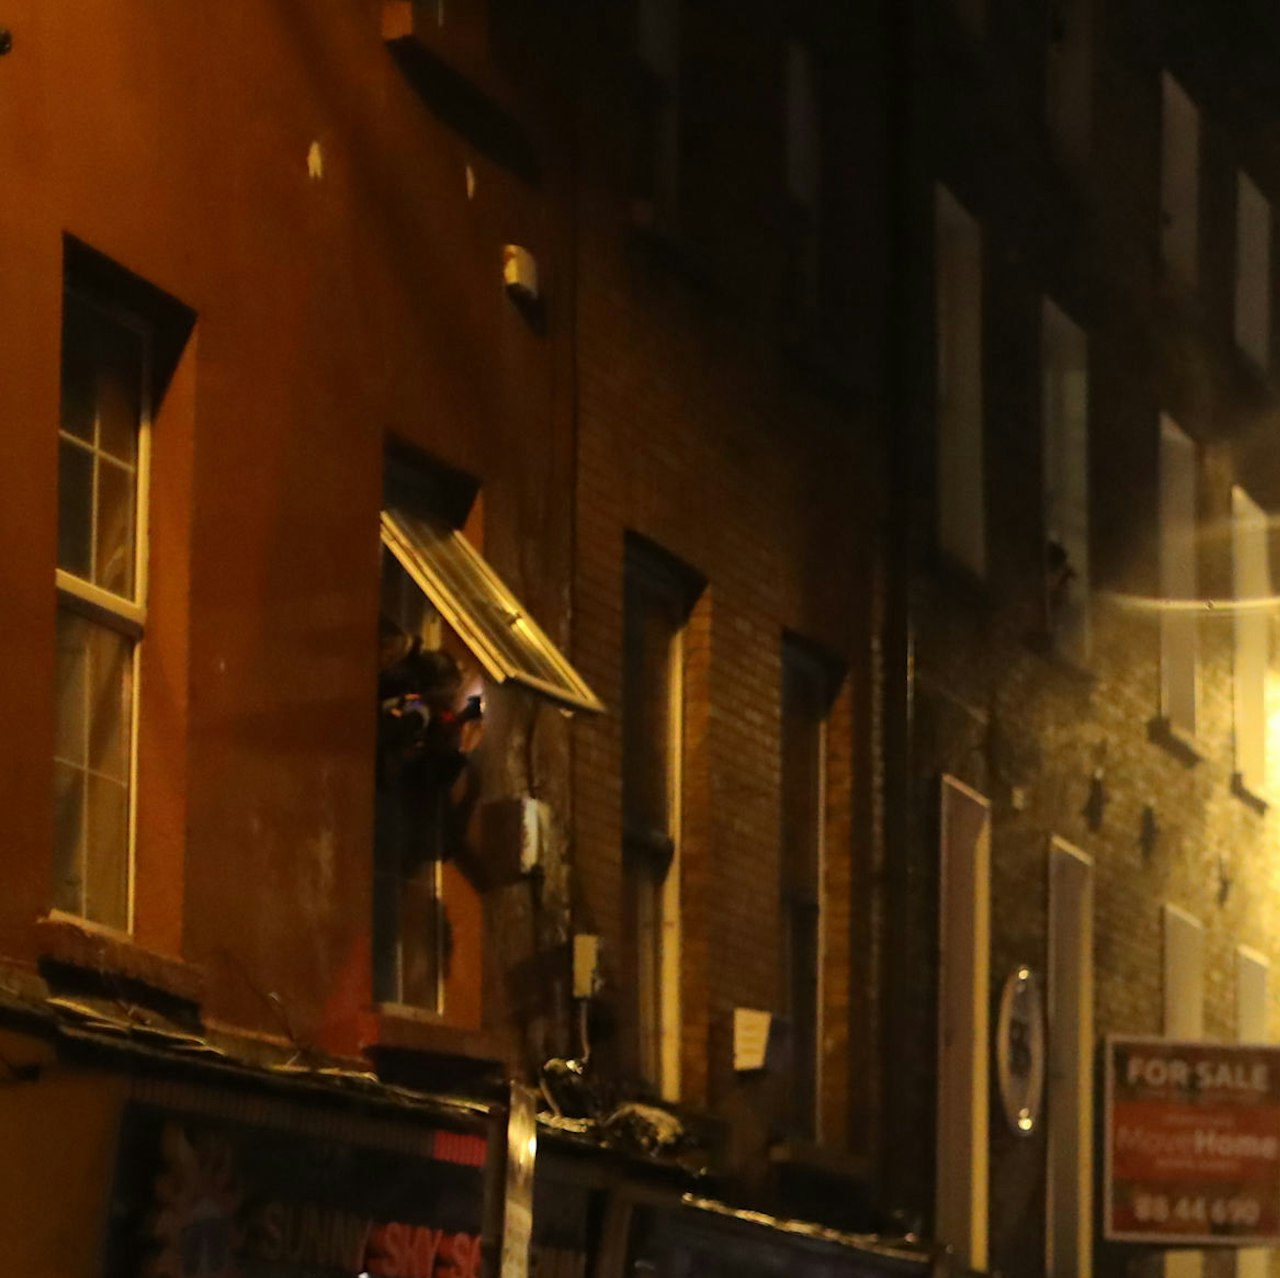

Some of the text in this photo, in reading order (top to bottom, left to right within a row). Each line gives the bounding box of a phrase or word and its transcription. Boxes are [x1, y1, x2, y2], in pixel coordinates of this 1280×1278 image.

[1127, 1057, 1268, 1092] FOR SALE
[260, 1202, 374, 1272] SUNNY
